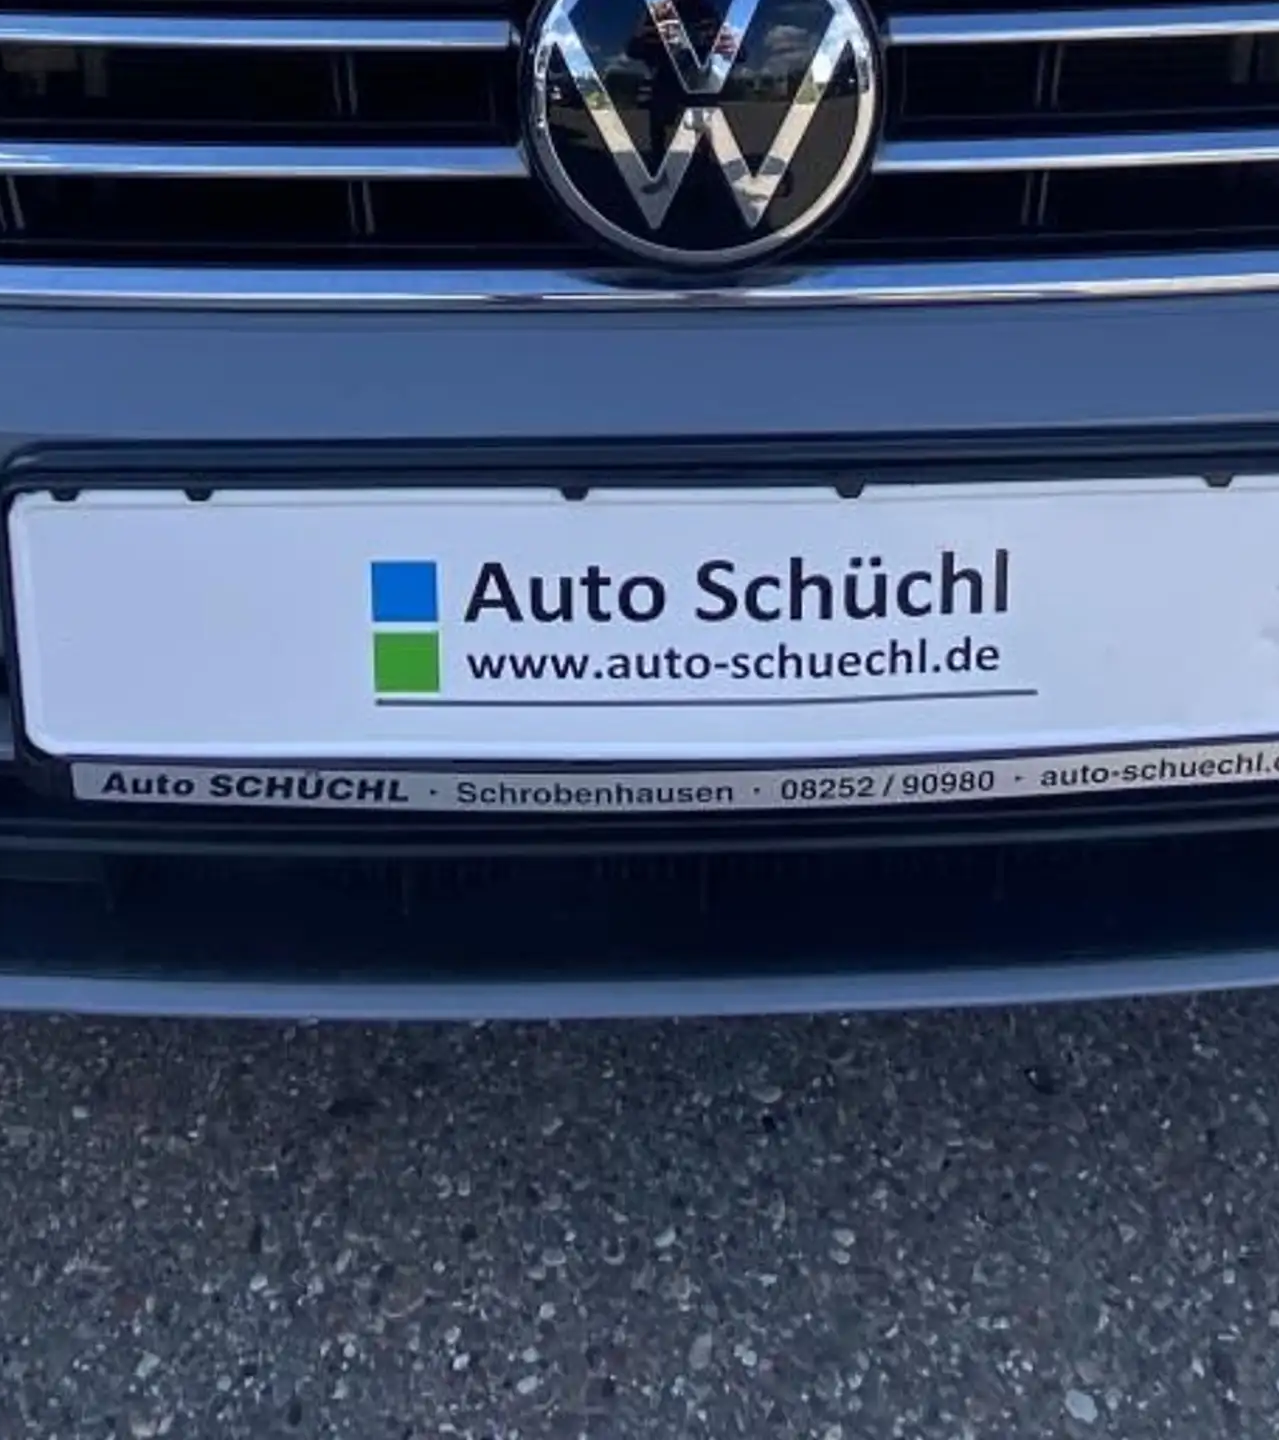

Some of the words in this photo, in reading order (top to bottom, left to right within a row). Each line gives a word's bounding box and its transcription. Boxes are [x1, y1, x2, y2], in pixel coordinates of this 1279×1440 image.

[464, 562, 666, 623] Auto
[695, 548, 1009, 622] Schüchl
[466, 635, 1000, 680] www.auto-schuechl.de
[102, 771, 195, 796] Auto
[209, 767, 410, 802] SCHÜCHL
[456, 781, 733, 805] Schrobenhausen
